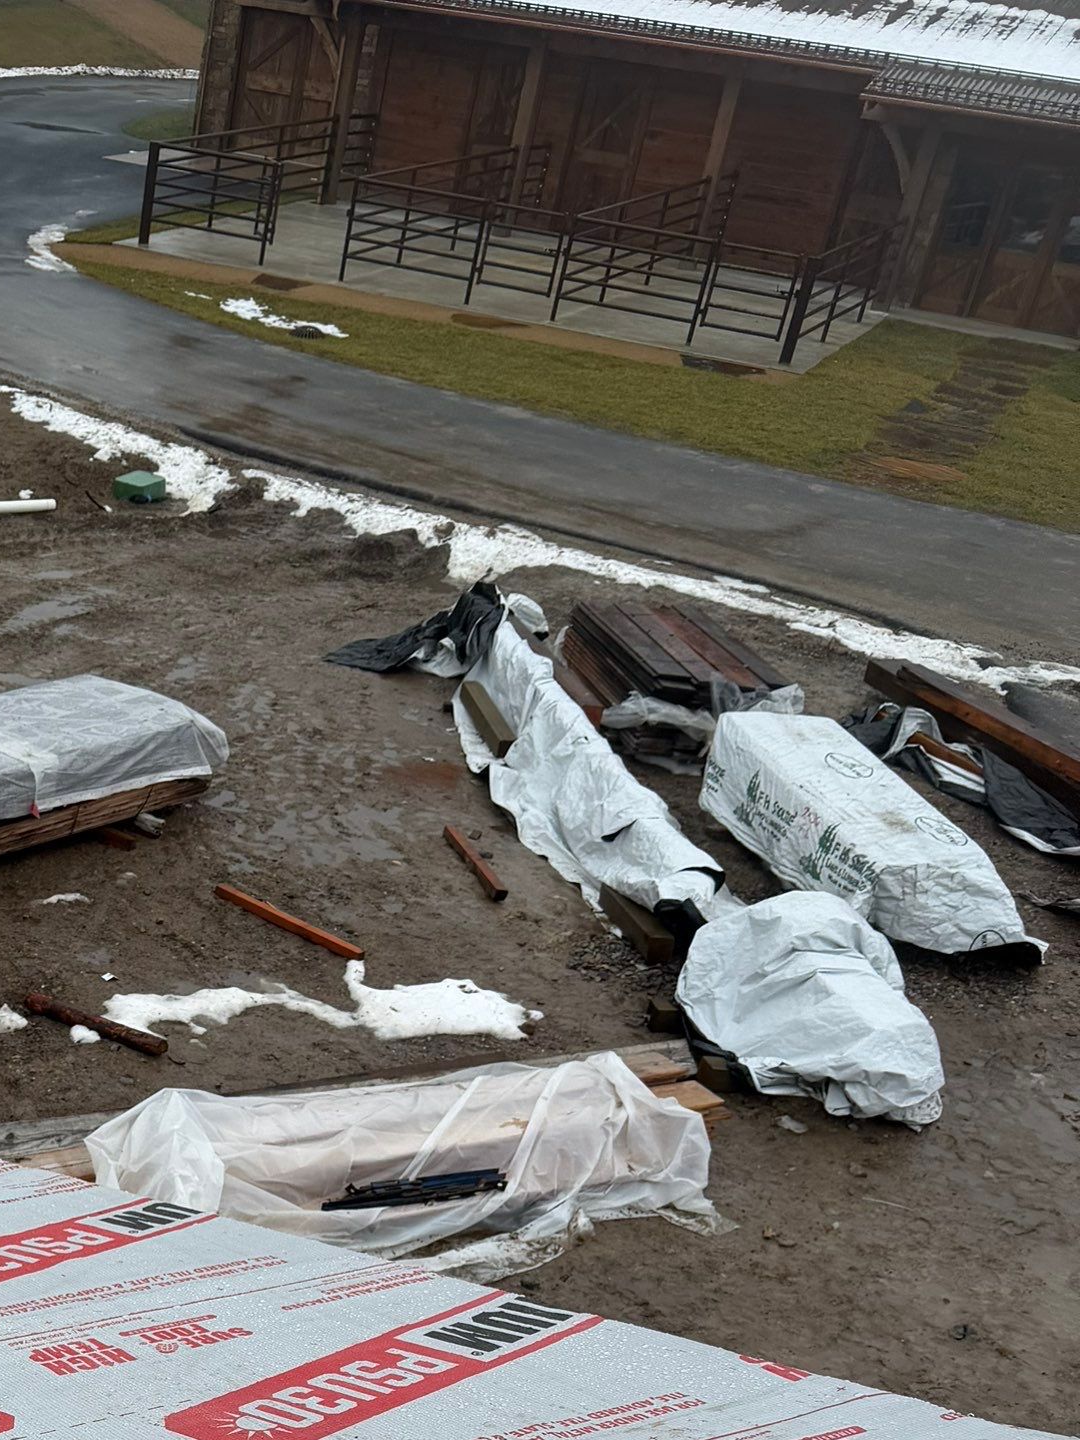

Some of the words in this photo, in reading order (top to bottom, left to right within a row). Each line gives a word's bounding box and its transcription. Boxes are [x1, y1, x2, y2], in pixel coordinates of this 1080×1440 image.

[28, 1338, 116, 1363] TEMP
[40, 1349, 137, 1376] HIGH
[239, 1346, 460, 1428] PSU30
